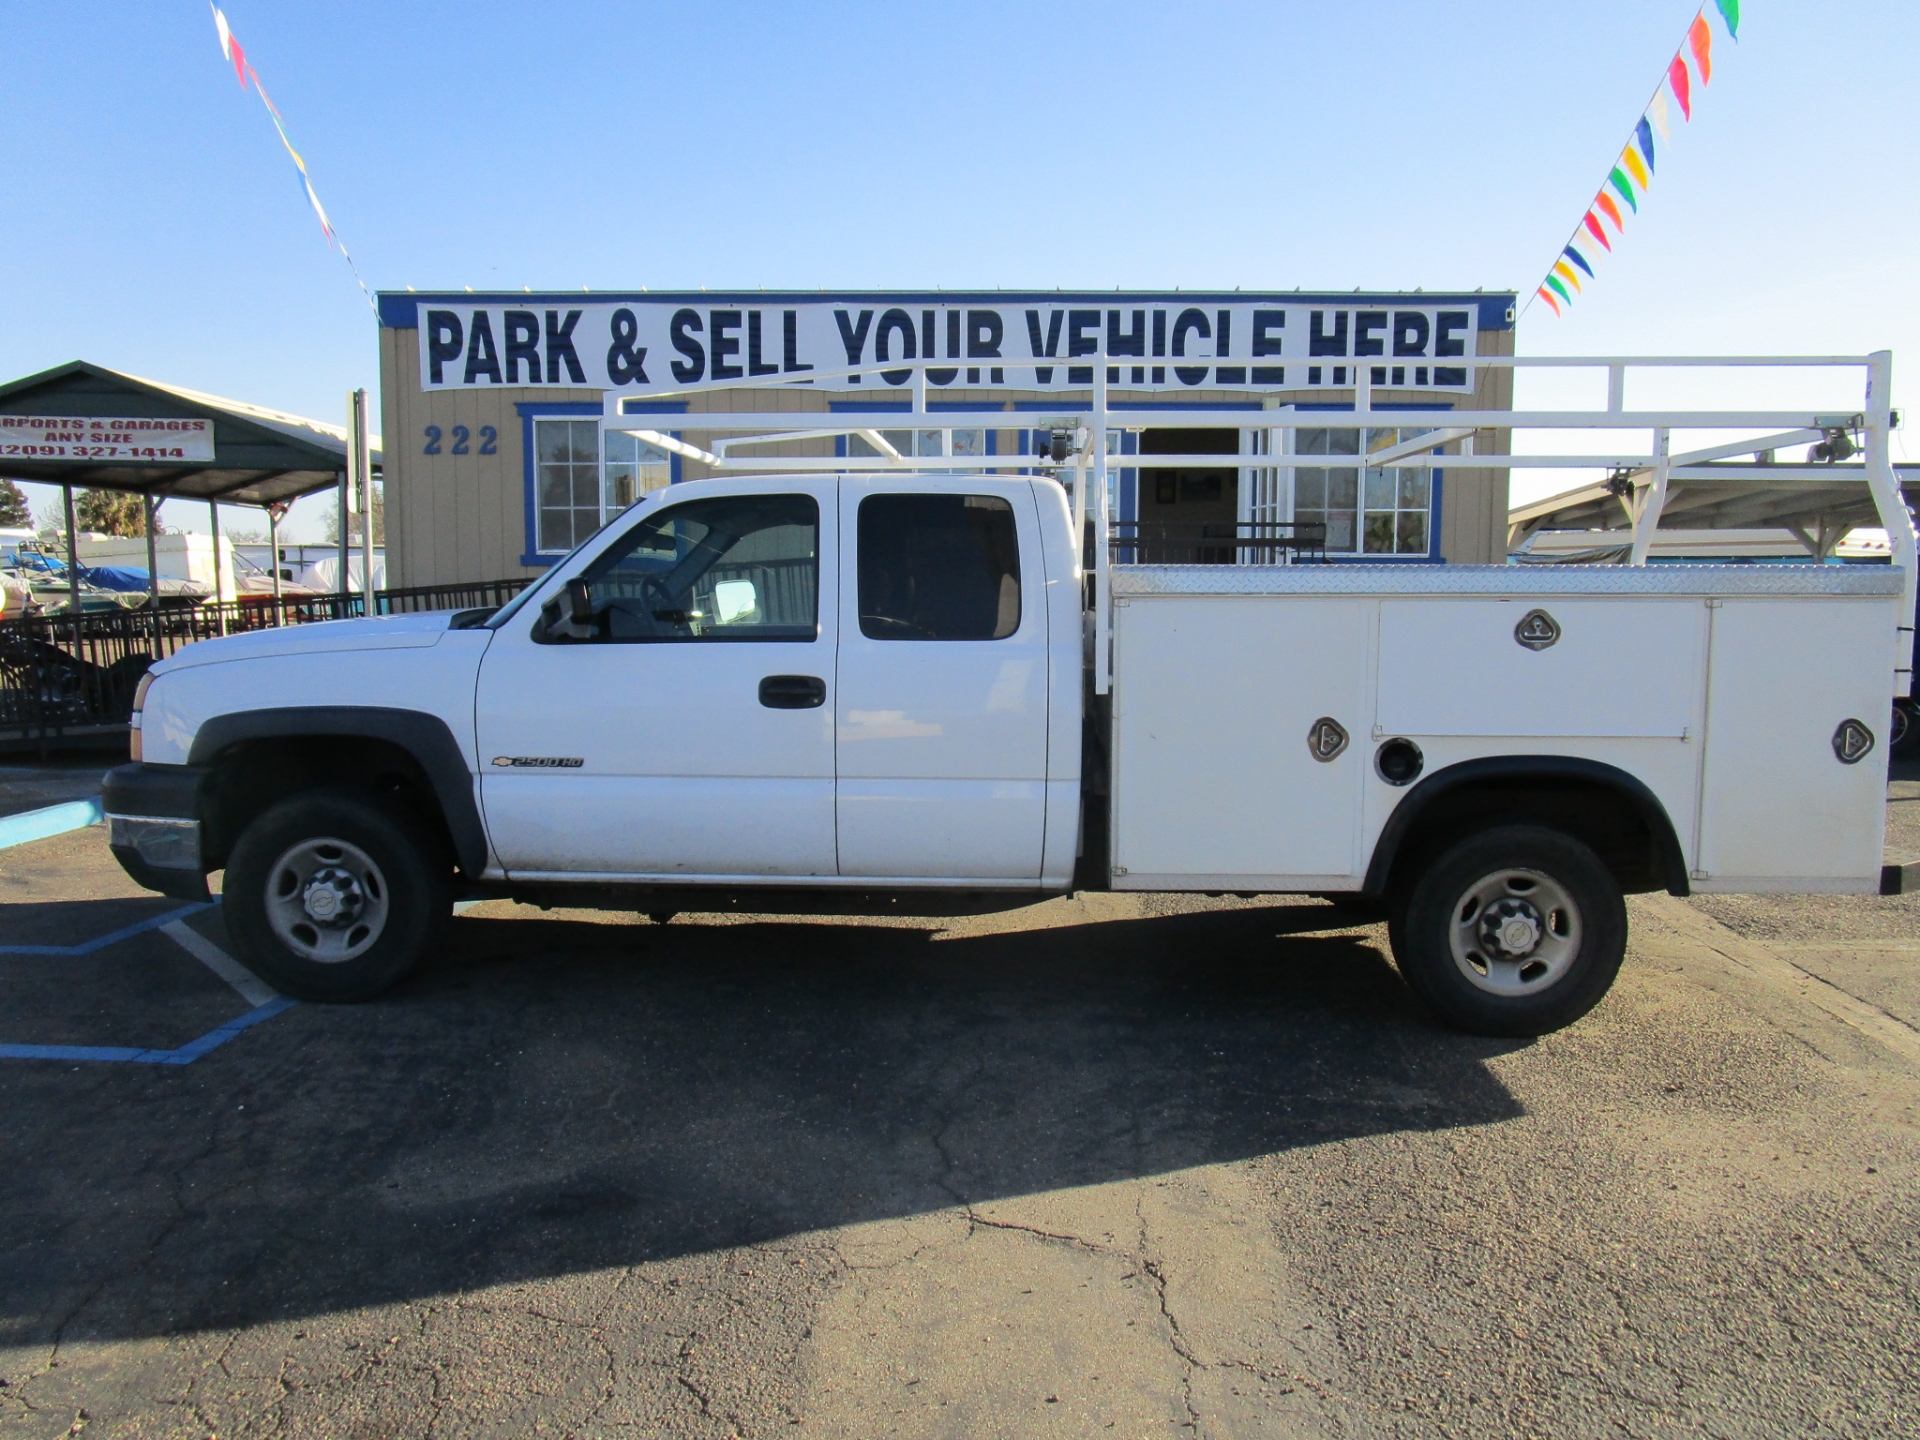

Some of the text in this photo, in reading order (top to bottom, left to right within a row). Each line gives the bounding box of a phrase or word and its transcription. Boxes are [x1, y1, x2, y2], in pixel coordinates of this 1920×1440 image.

[427, 308, 1469, 386] PARK & SELL YOUR VEHICLE HERE
[0, 418, 205, 430] RPORTS & GARAGES
[44, 432, 133, 443] ANY SIZE
[423, 425, 497, 455] 222
[72, 446, 184, 457] 327-1414
[514, 756, 581, 767] 2500 HD
